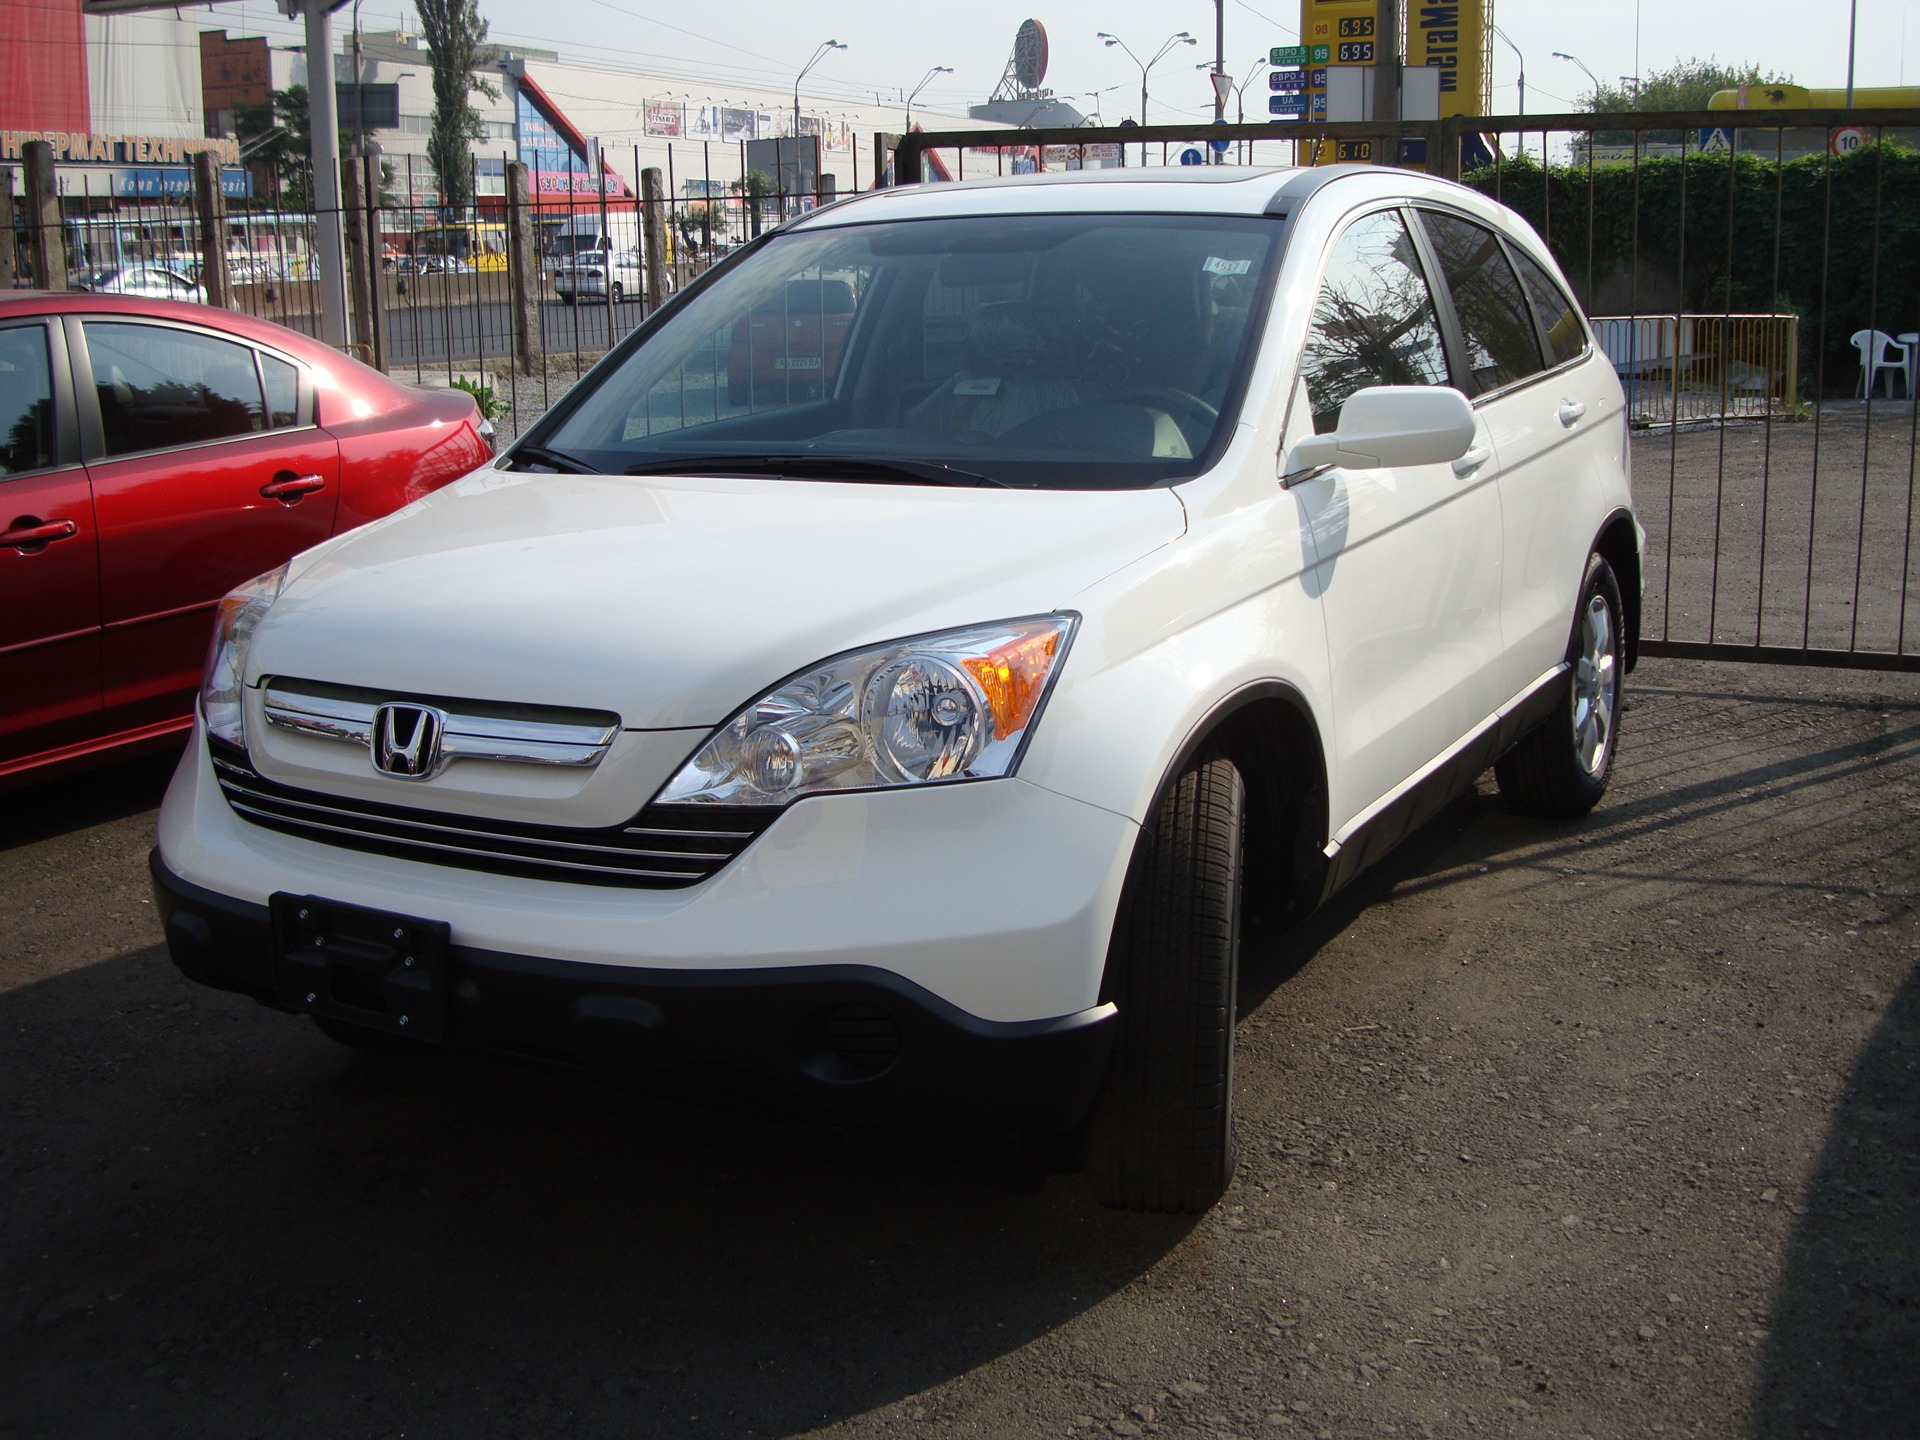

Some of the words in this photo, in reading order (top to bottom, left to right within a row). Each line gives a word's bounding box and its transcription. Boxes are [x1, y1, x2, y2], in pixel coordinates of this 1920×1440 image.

[1315, 24, 1329, 35] 98
[1272, 47, 1297, 57] ЄВРО
[1300, 46, 1306, 56] 5
[1314, 48, 1328, 60] 95
[1271, 72, 1296, 82] ЄВРО
[1299, 71, 1305, 81] 4
[1314, 73, 1326, 85] 95
[1282, 96, 1294, 106] UA
[1314, 97, 1326, 109] 95
[1840, 136, 1859, 151] 10
[1313, 146, 1326, 158] 2
